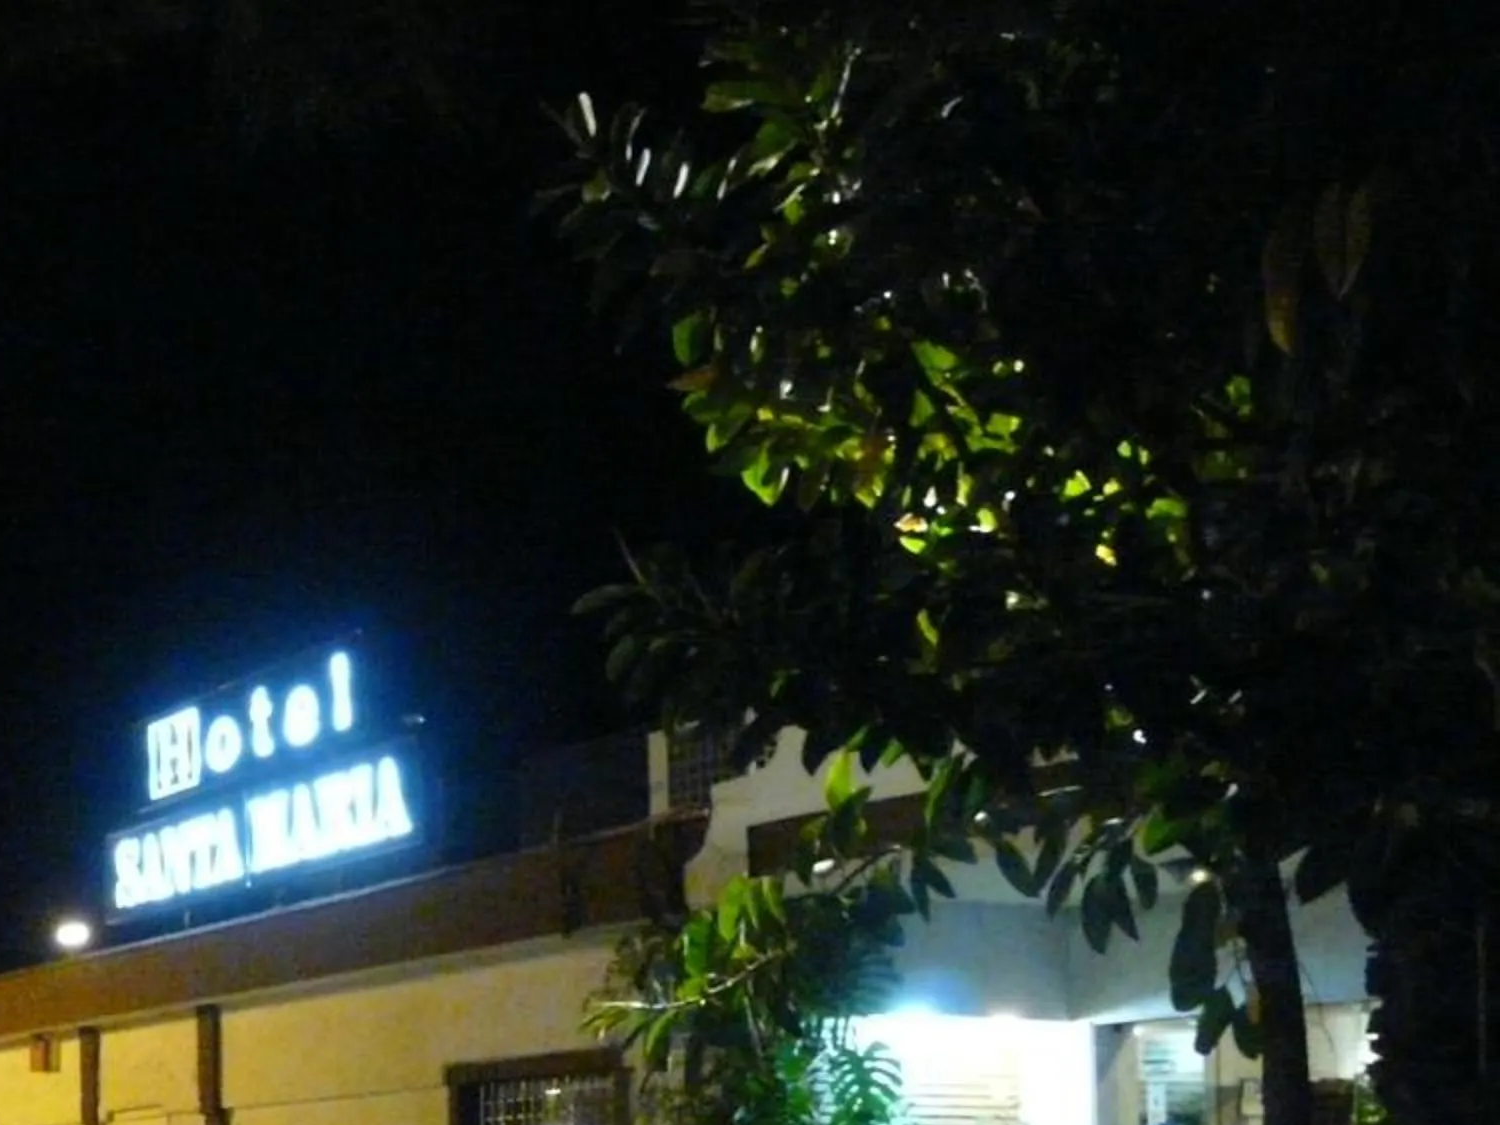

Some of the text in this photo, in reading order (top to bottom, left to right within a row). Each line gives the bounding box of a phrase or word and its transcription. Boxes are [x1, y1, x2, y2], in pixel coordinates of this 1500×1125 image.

[147, 651, 352, 800] Hotel
[114, 756, 413, 909] SANTA MARIA
